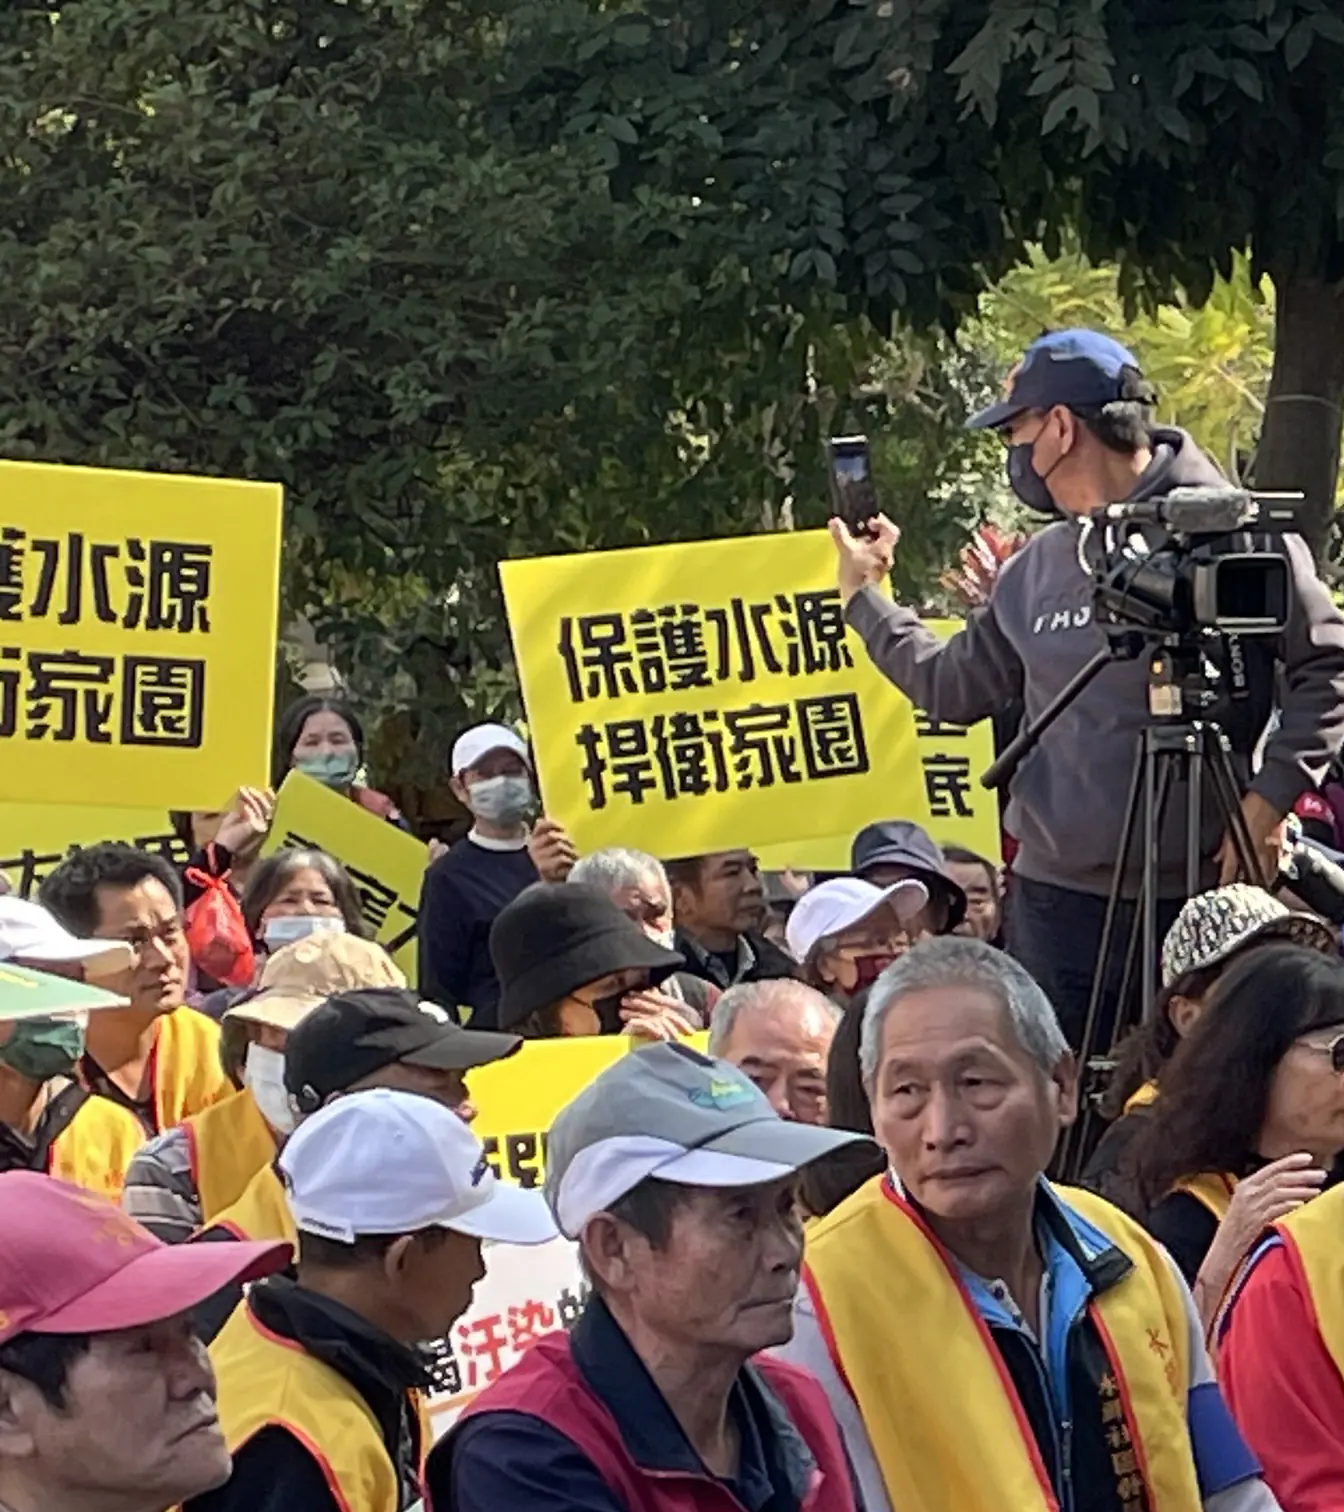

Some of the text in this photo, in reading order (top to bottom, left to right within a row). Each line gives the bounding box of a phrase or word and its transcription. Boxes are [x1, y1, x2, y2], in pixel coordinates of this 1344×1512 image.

[558, 588, 855, 703] 保護水源
[576, 693, 870, 810] 捍衛家園
